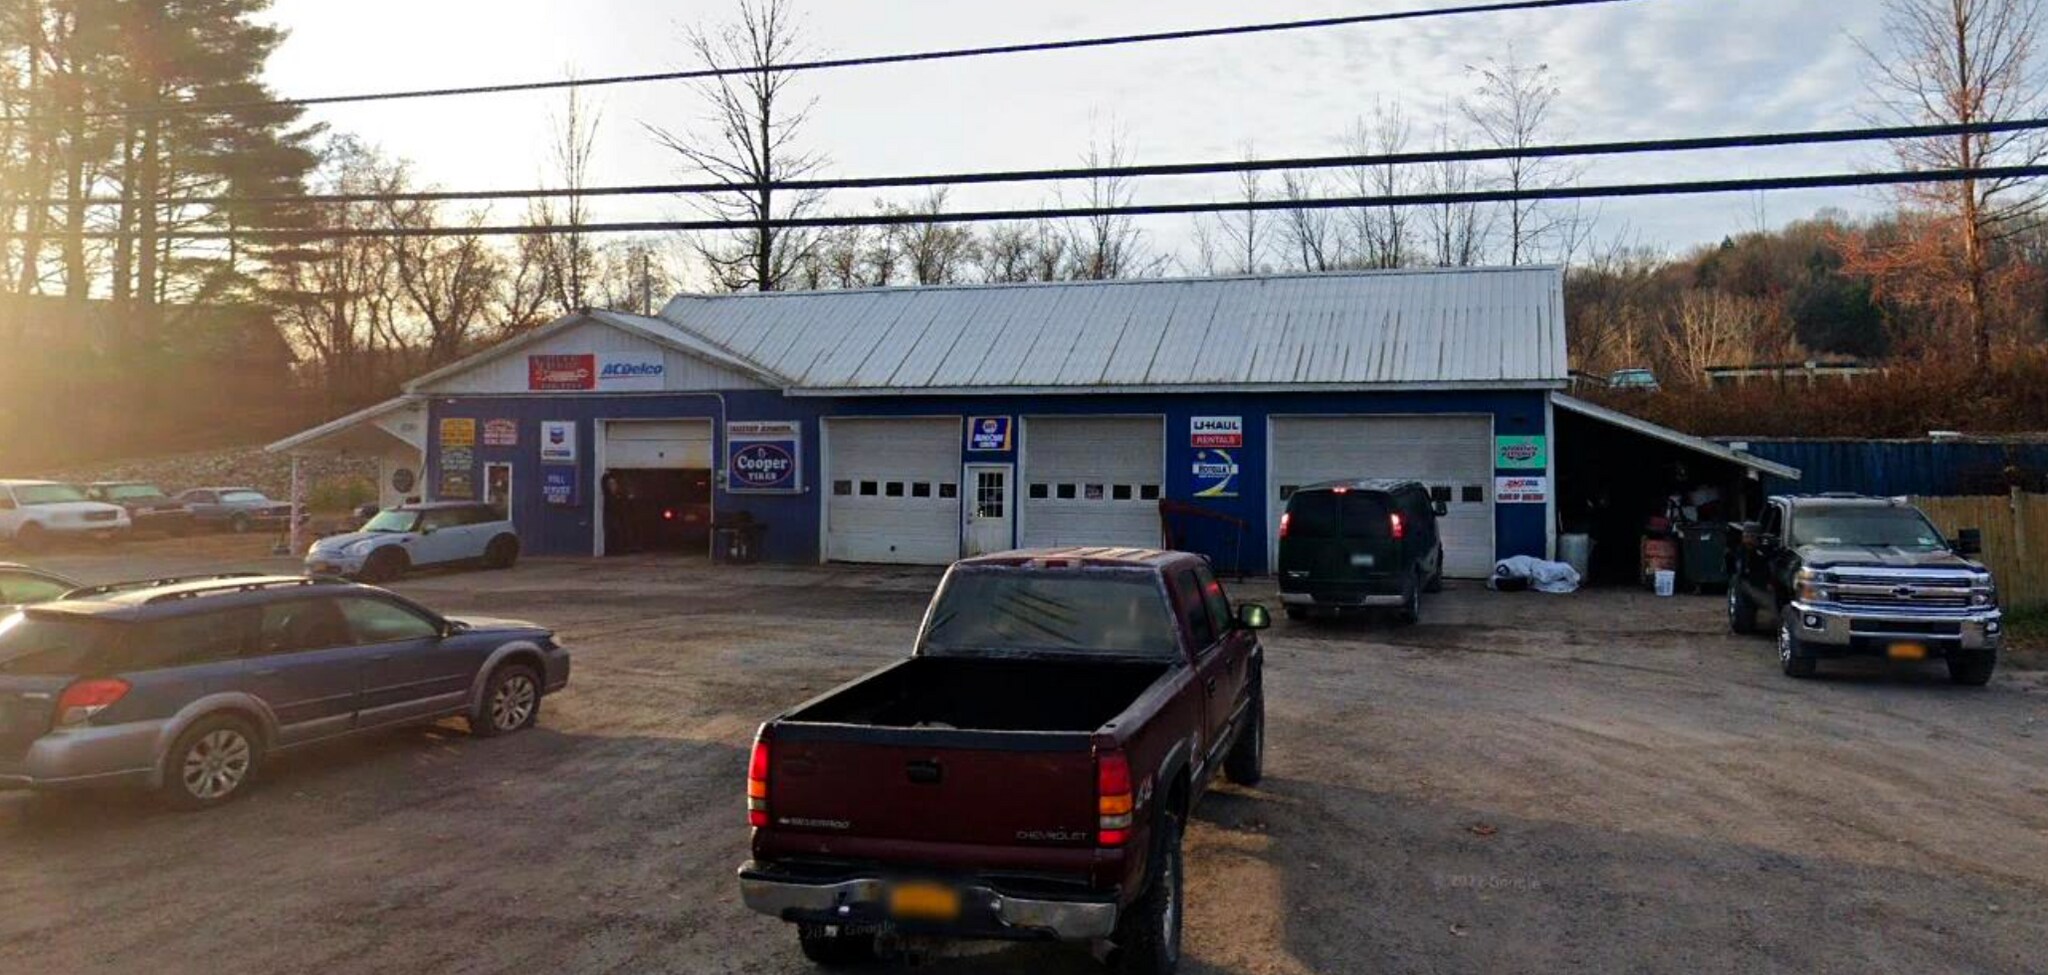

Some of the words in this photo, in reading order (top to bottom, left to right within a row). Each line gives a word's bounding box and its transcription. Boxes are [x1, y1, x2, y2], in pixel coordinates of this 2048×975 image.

[602, 363, 662, 375] ACDelco
[1193, 421, 1239, 430] U-HAUL
[1196, 435, 1236, 445] RENTALS
[737, 455, 788, 472] Cooper
[748, 472, 777, 480] TIRES
[1015, 831, 1088, 841] CHEVROLET
